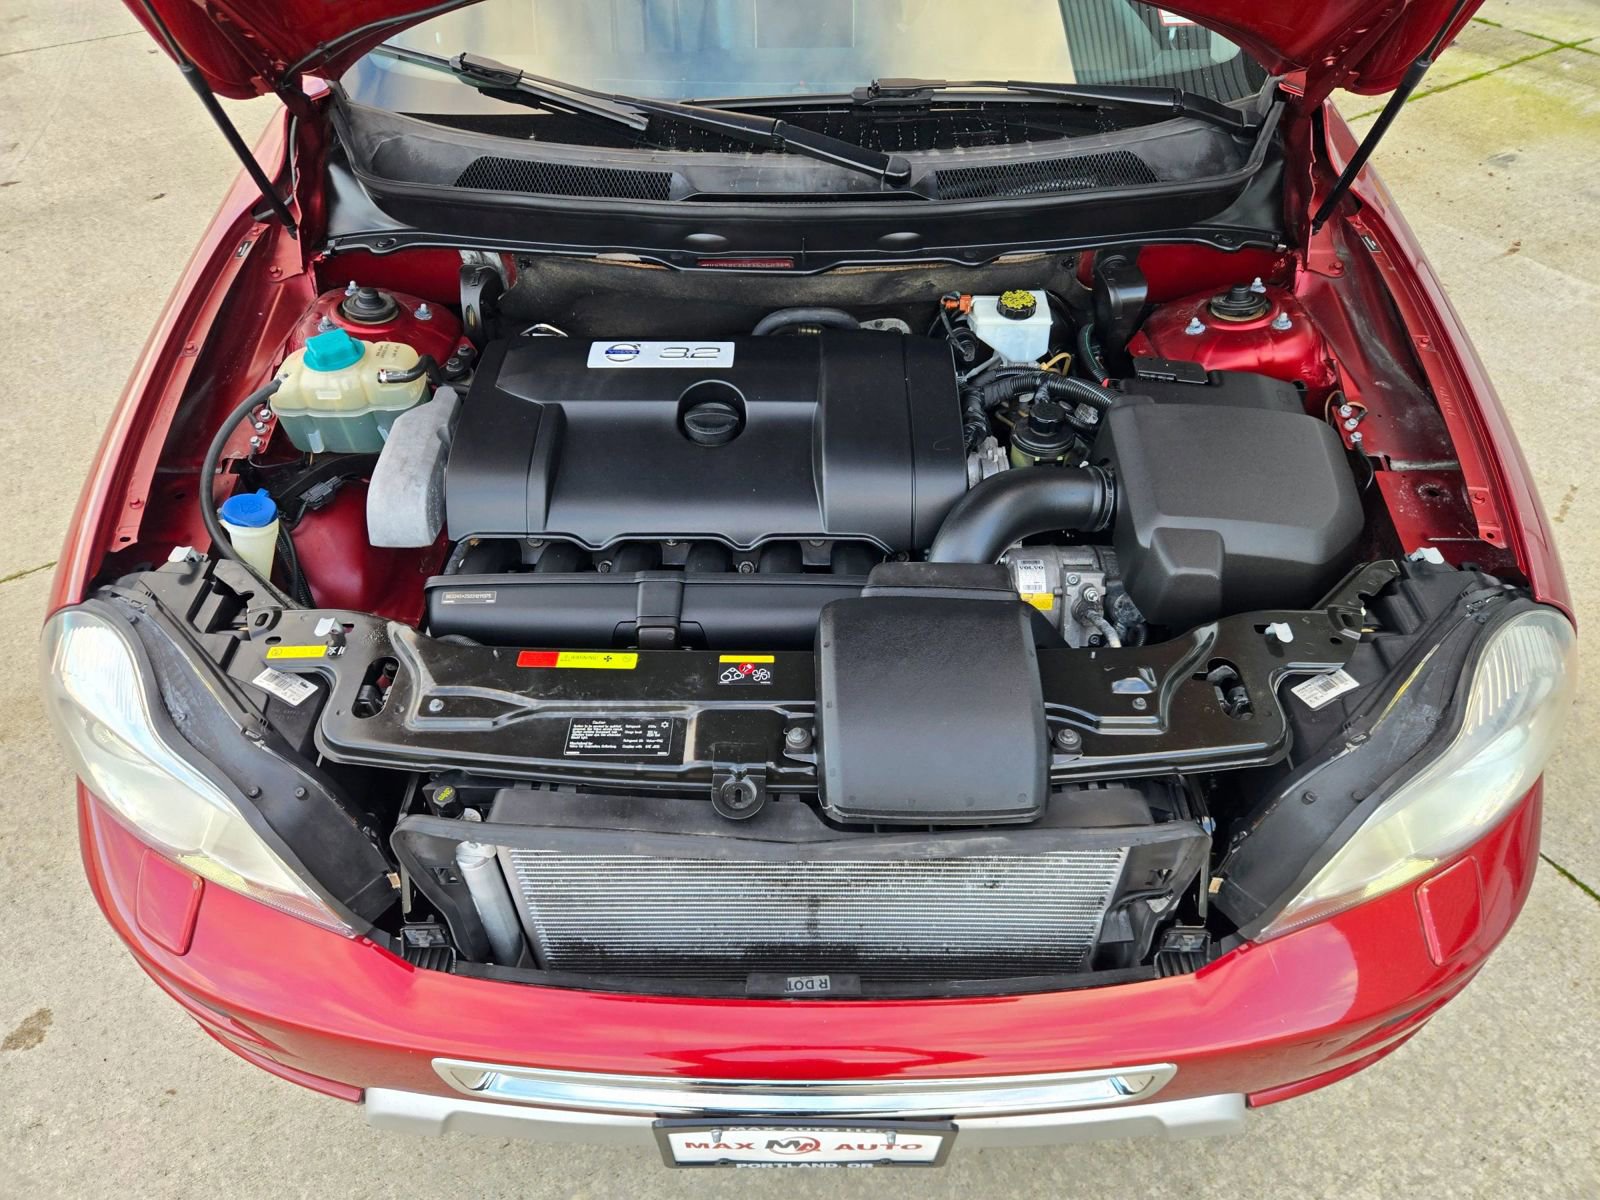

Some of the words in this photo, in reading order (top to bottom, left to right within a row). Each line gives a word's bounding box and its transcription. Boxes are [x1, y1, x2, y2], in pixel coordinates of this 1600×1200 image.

[660, 346, 721, 359] 3.2
[685, 1141, 755, 1150] MAX
[835, 1142, 923, 1151] AUTO
